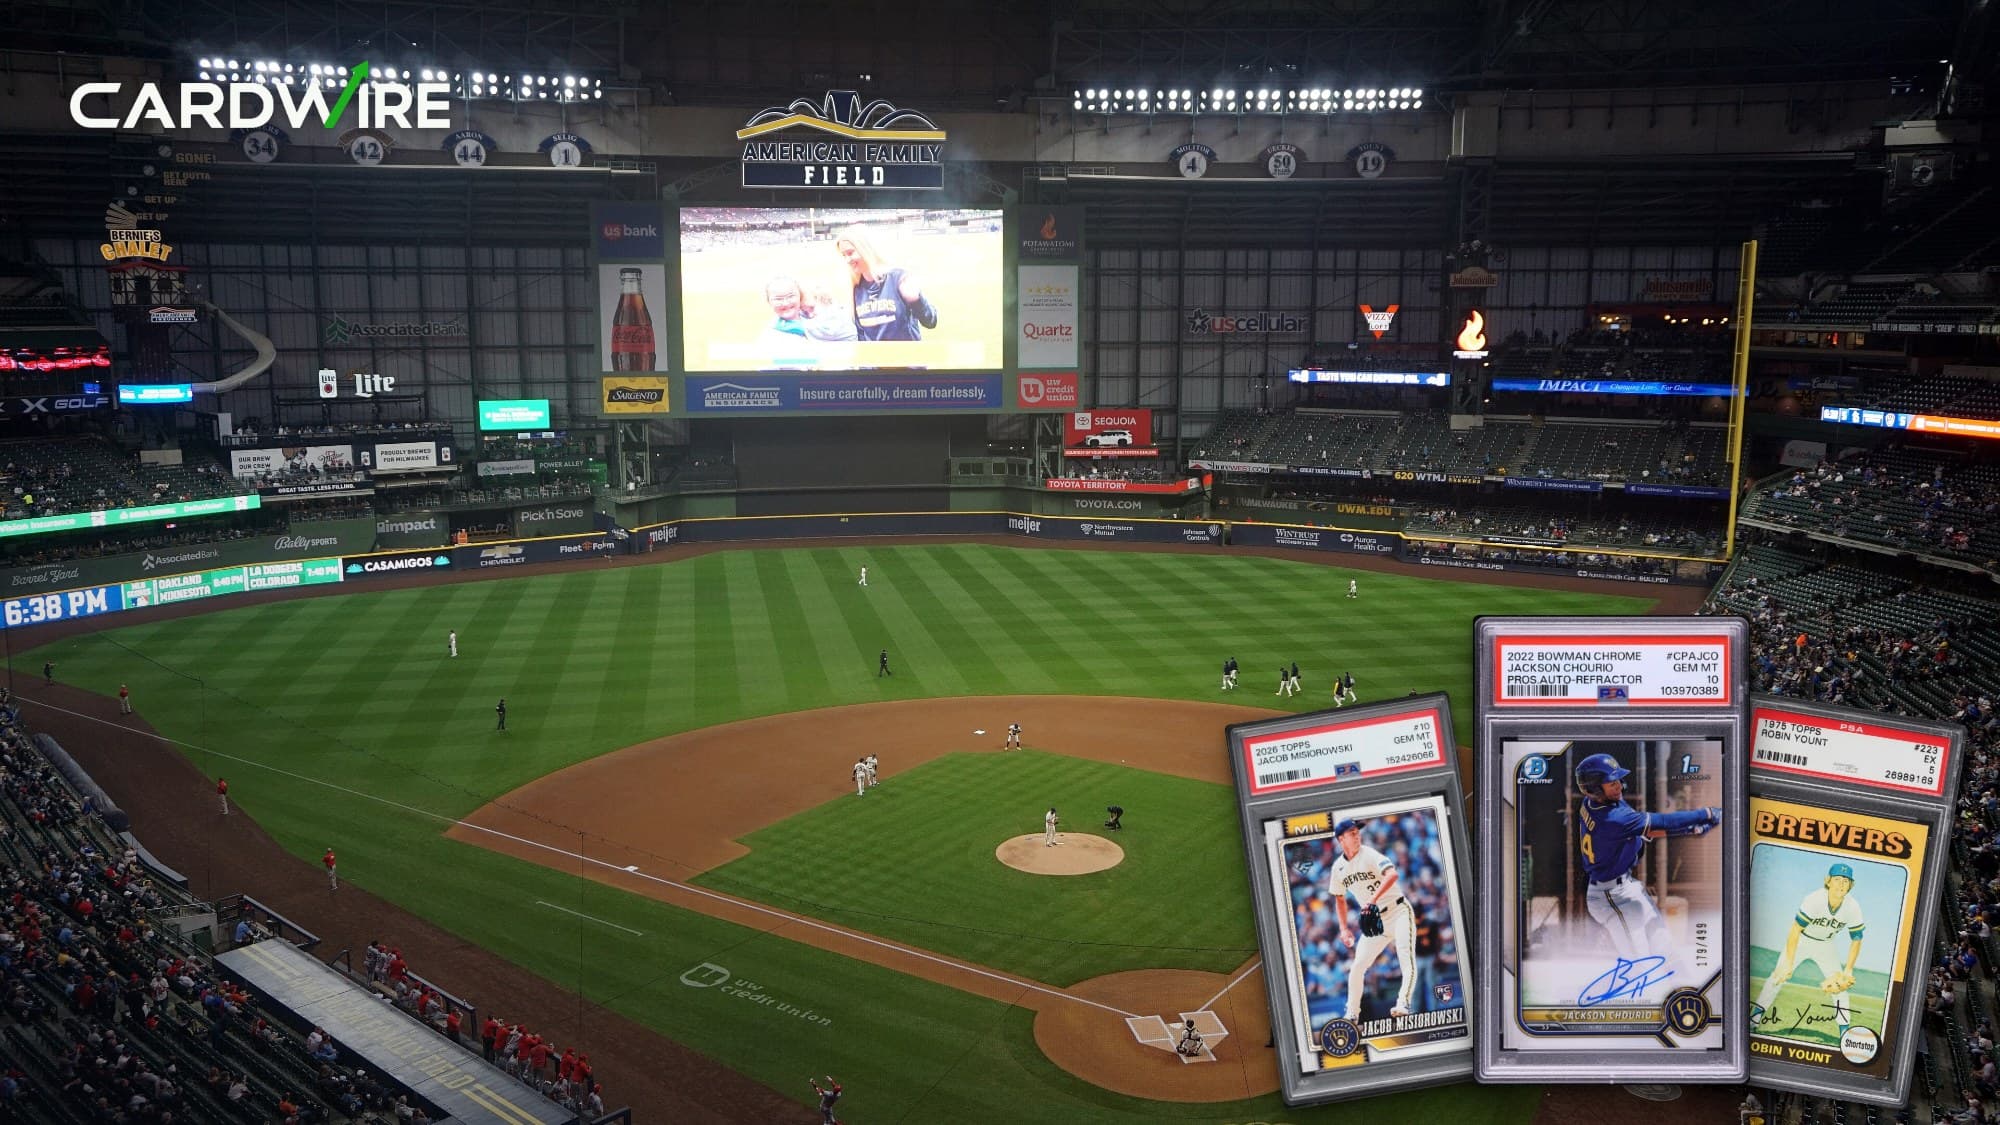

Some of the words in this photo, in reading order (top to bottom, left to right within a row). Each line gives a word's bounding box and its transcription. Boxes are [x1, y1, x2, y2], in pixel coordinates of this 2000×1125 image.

[455, 131, 483, 141] AARON
[552, 133, 577, 142] SELIG
[247, 138, 274, 157] 34
[356, 142, 381, 159] 42
[457, 144, 483, 162] 44
[742, 142, 857, 162] AMERICAN
[865, 142, 943, 163] FAMILY
[1176, 145, 1210, 155] MOLITOR
[1267, 144, 1296, 154] UECKER
[176, 152, 217, 164] GONE!
[562, 148, 570, 164] 1
[1273, 154, 1291, 169] 50
[1185, 157, 1197, 172] 4
[1360, 156, 1383, 172] 19
[804, 165, 884, 185] FIELD
[144, 195, 162, 204] GET
[164, 196, 177, 204] UP
[136, 212, 154, 221] GET
[155, 213, 169, 221] UP
[111, 230, 160, 241] BERNIE'S
[604, 226, 621, 237] us
[623, 224, 657, 237] bank
[100, 241, 173, 262] CHALET
[1210, 312, 1305, 332] uscellular
[1364, 312, 1393, 321] VIZZY
[1023, 322, 1073, 340] Quartz
[353, 373, 395, 398] Lite
[1046, 385, 1074, 393] credit
[1538, 379, 1601, 392] IMPACT
[612, 390, 658, 401] SARGENTO
[705, 391, 748, 399] AMERICAN
[750, 391, 779, 399] FAMILY
[800, 388, 836, 400] Insure
[838, 387, 890, 401] carefully,
[892, 386, 928, 399] dream
[930, 386, 986, 402] fearlessly.
[1046, 393, 1075, 401] union
[21, 397, 48, 413] X
[54, 398, 109, 409] GOLF
[1094, 416, 1137, 427] SEQUOIA
[564, 460, 584, 468] ALLEY
[1394, 471, 1414, 480] 620
[1416, 472, 1447, 482] WTMJ
[1049, 480, 1081, 489] TOYOTA
[1082, 481, 1127, 489] TERRITORY
[1074, 499, 1142, 510] TOYOTA.COM
[1337, 504, 1392, 516] UWM.EDU
[521, 509, 545, 522] Pick
[555, 508, 584, 519] Save
[385, 517, 436, 533] impact
[1008, 516, 1041, 534] meijer
[650, 525, 678, 544] meijer
[1275, 529, 1320, 540] WINTRUST
[1354, 535, 1377, 545] Aurora
[275, 535, 312, 550] Bally
[311, 537, 338, 547] SPORTS
[560, 545, 583, 553] Fleet
[1354, 543, 1375, 551] Health
[1377, 544, 1393, 552] Care
[156, 552, 201, 565] Associated
[201, 550, 220, 559] Bank
[480, 556, 526, 566] CHEVROLET
[250, 565, 262, 577] LA
[364, 556, 433, 573] CASAMIGOS
[11, 570, 48, 586] Barrel
[50, 567, 80, 582] Yard
[158, 574, 202, 589] OAKLAND
[250, 575, 300, 588] COLORADO
[159, 585, 212, 602] MINNESOTA
[4, 593, 63, 626] 6:38
[67, 587, 108, 616] PM
[734, 978, 764, 992] uw
[720, 983, 774, 1007] credit
[776, 1001, 832, 1027] union
